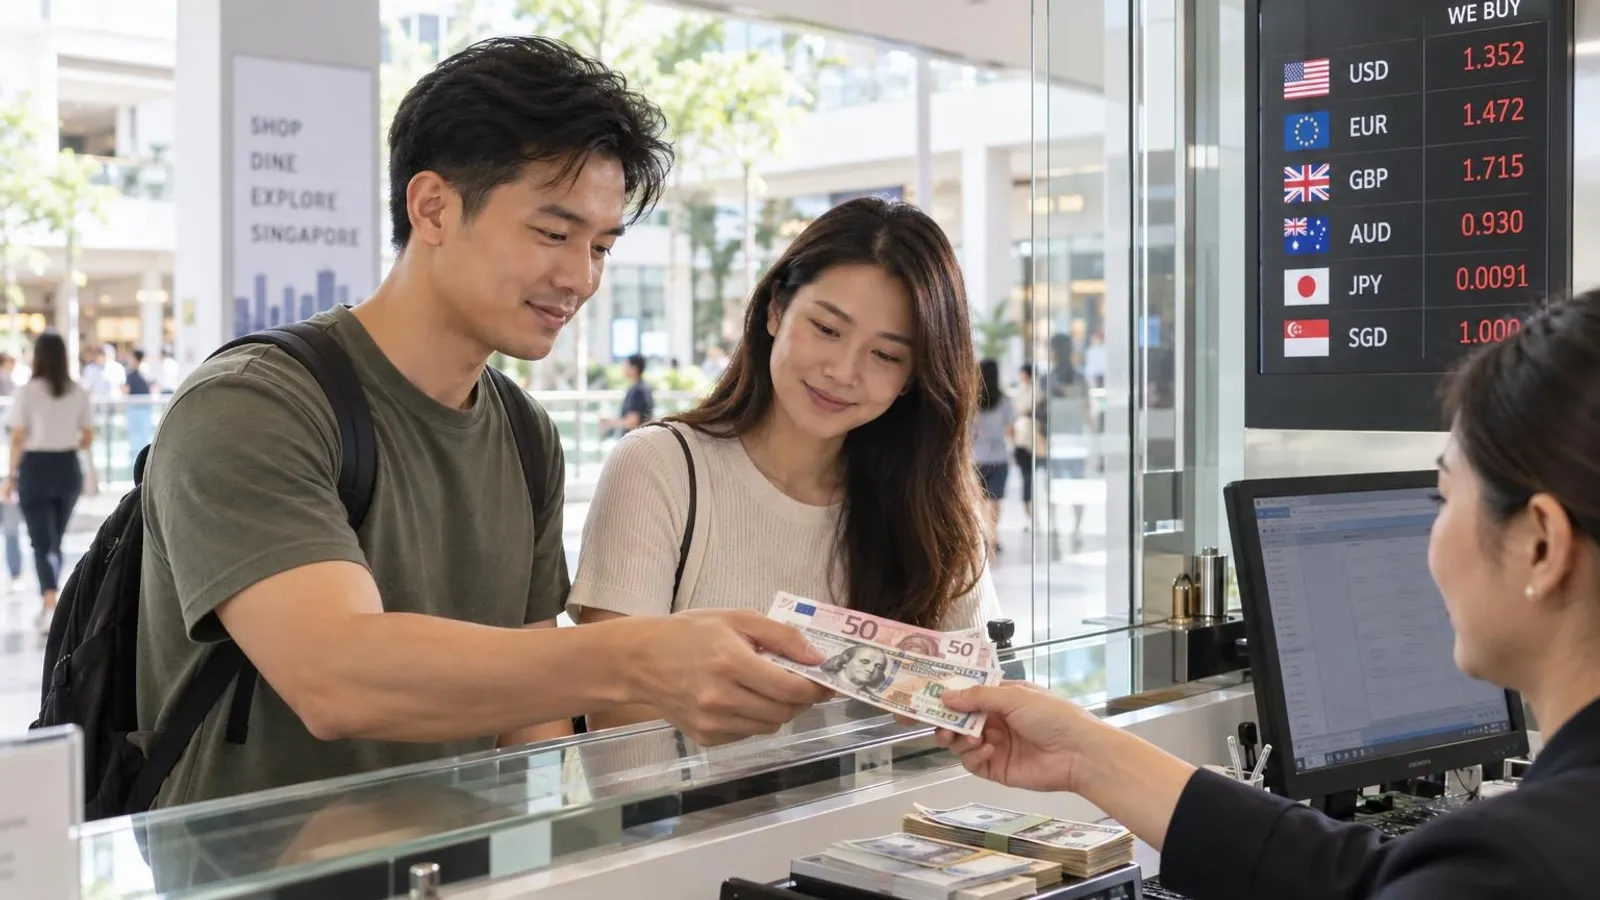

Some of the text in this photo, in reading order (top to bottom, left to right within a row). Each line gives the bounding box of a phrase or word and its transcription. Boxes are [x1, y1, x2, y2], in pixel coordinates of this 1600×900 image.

[1447, 0, 1521, 25] WE BUY
[1349, 40, 1525, 84] USD 1.352
[250, 116, 302, 138] SHOP
[1349, 97, 1525, 138] EUR 1.472
[250, 151, 297, 173] DINE
[1349, 153, 1524, 190] GBP 1.715
[250, 186, 337, 211] EXPLORE
[250, 223, 360, 247] SINGAPORE
[1349, 209, 1523, 245] AUD 0.930
[1348, 265, 1528, 296] JPY 0.0091
[1348, 318, 1520, 348] SGD 1.000
[841, 615, 878, 641] 50
[947, 640, 973, 657] 50
